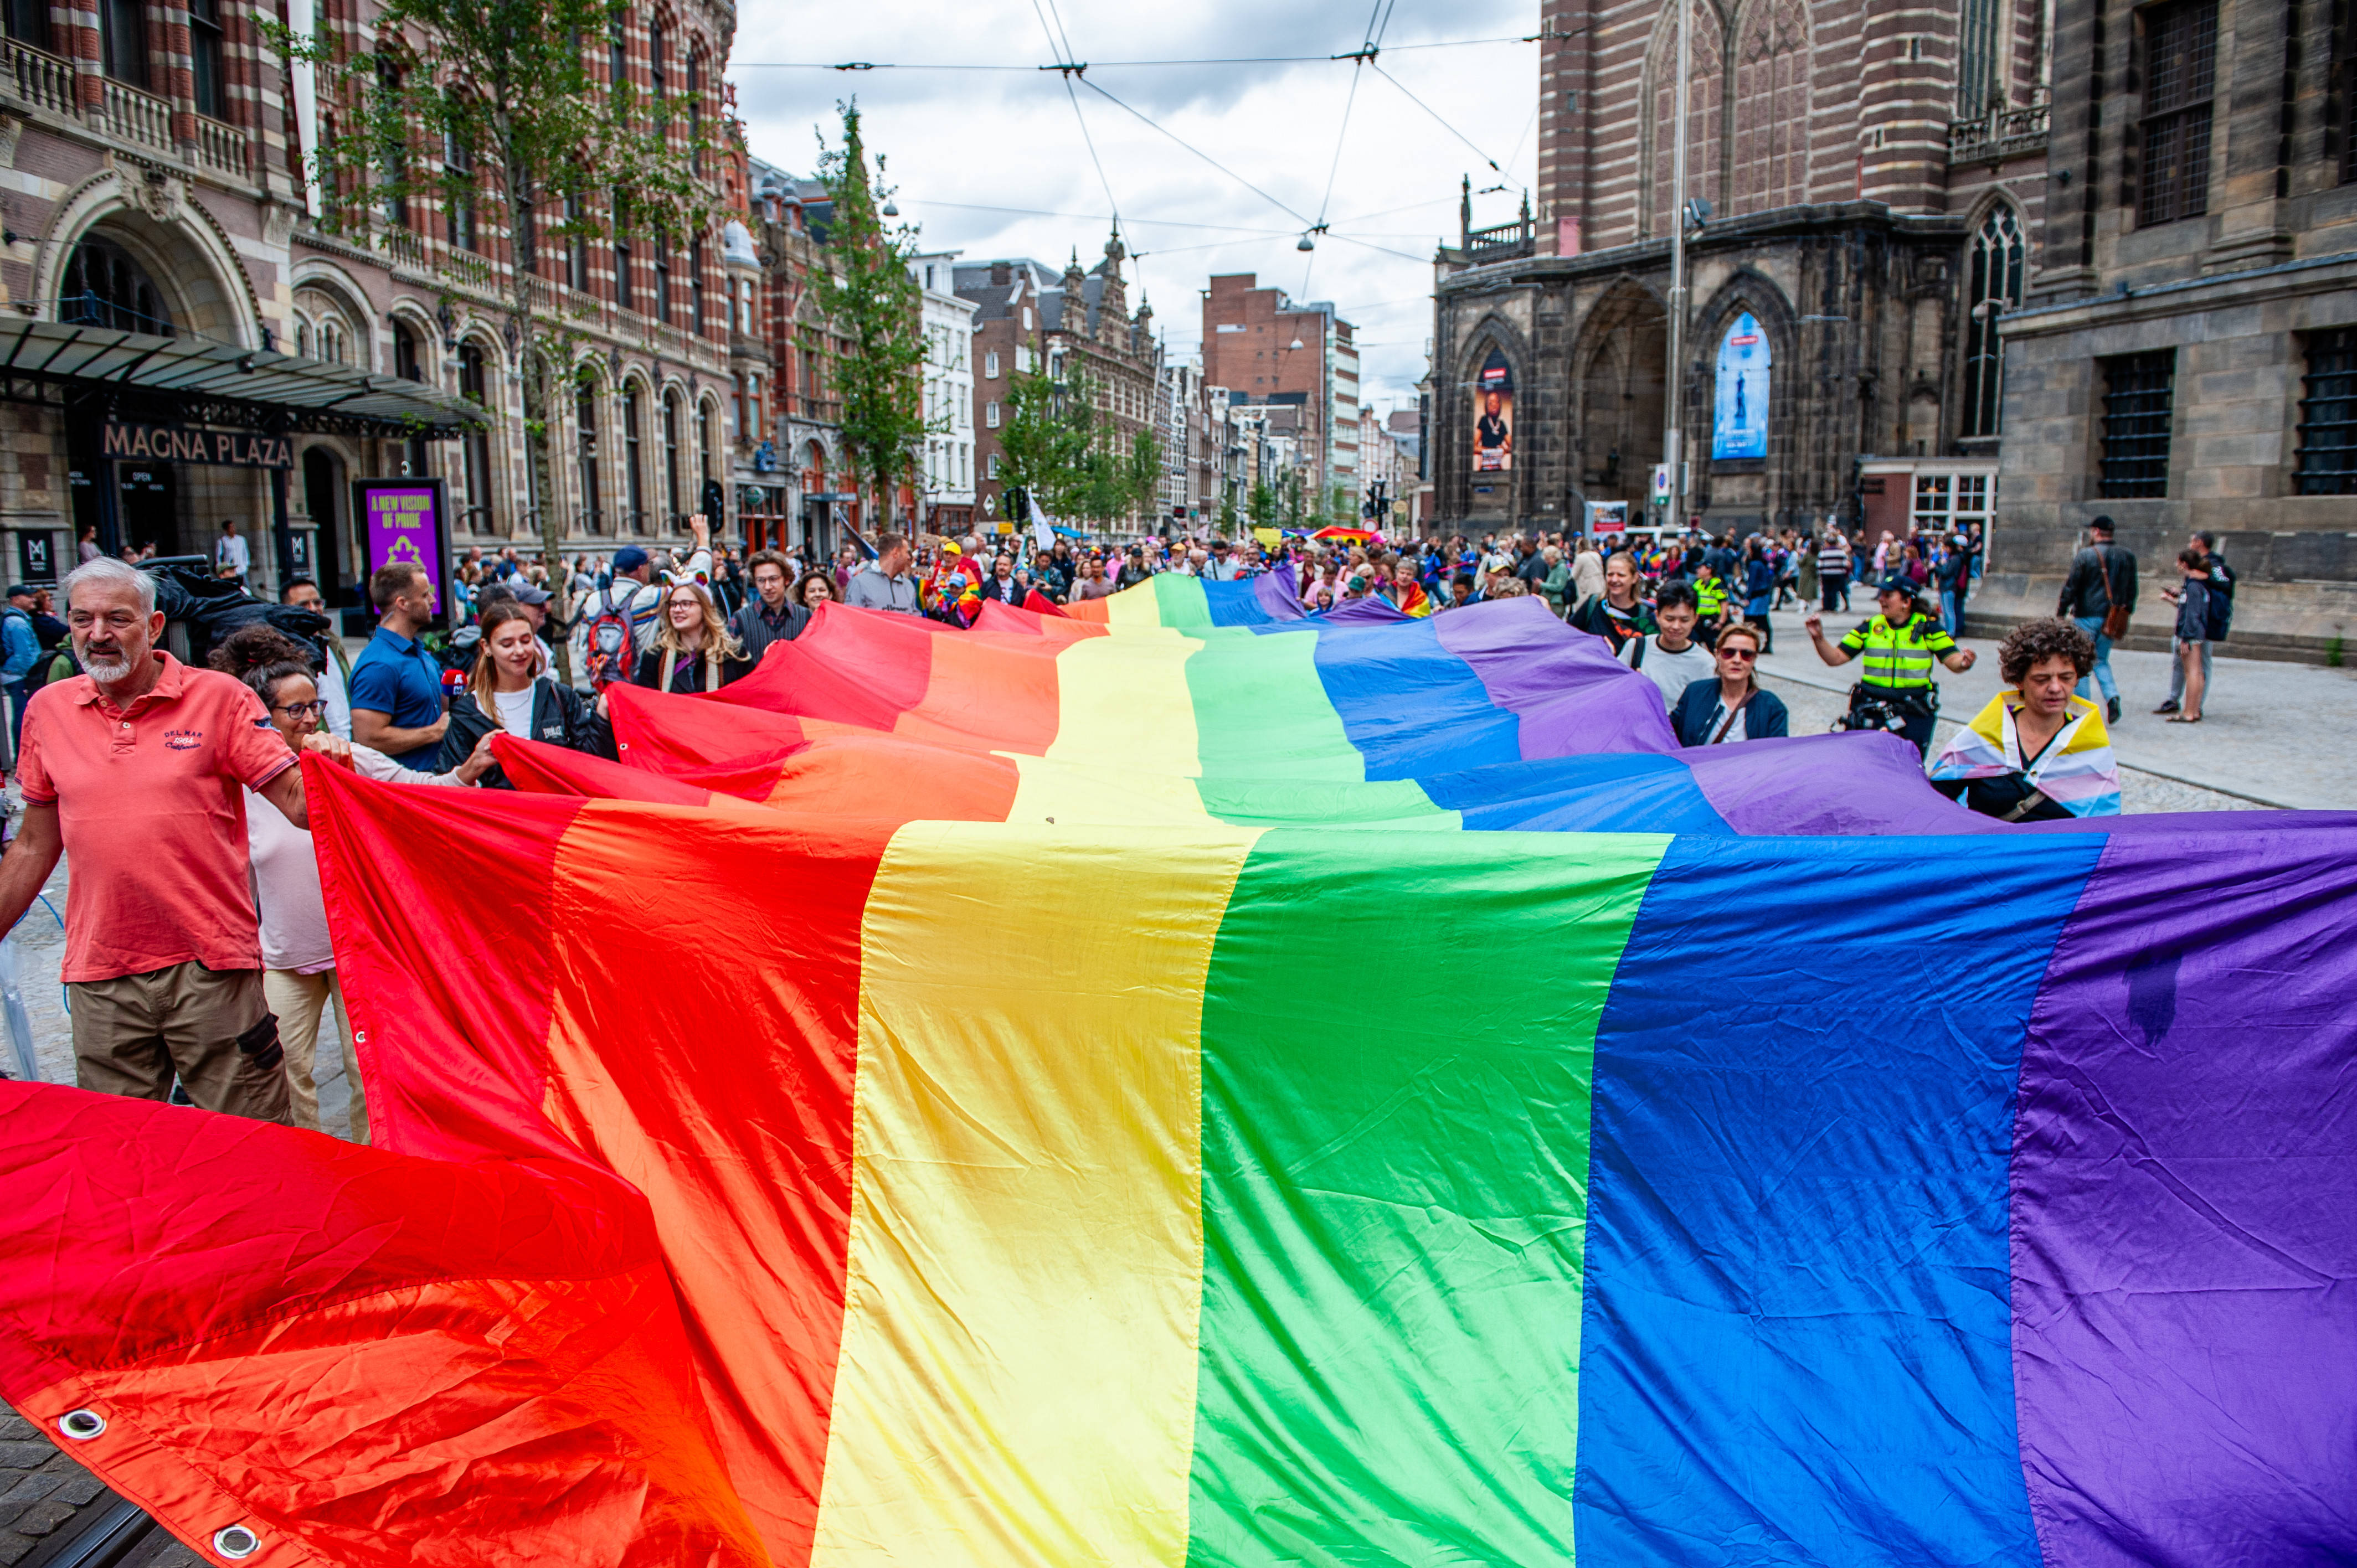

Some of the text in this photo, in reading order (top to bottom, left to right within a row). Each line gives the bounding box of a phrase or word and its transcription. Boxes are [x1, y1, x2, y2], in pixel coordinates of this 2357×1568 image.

[104, 424, 292, 467] MAGNA PLAZA
[132, 472, 152, 482] OPEN
[372, 495, 430, 511] A NEW VISION
[382, 513, 421, 529] OF PRIDE
[184, 730, 203, 738] MAR
